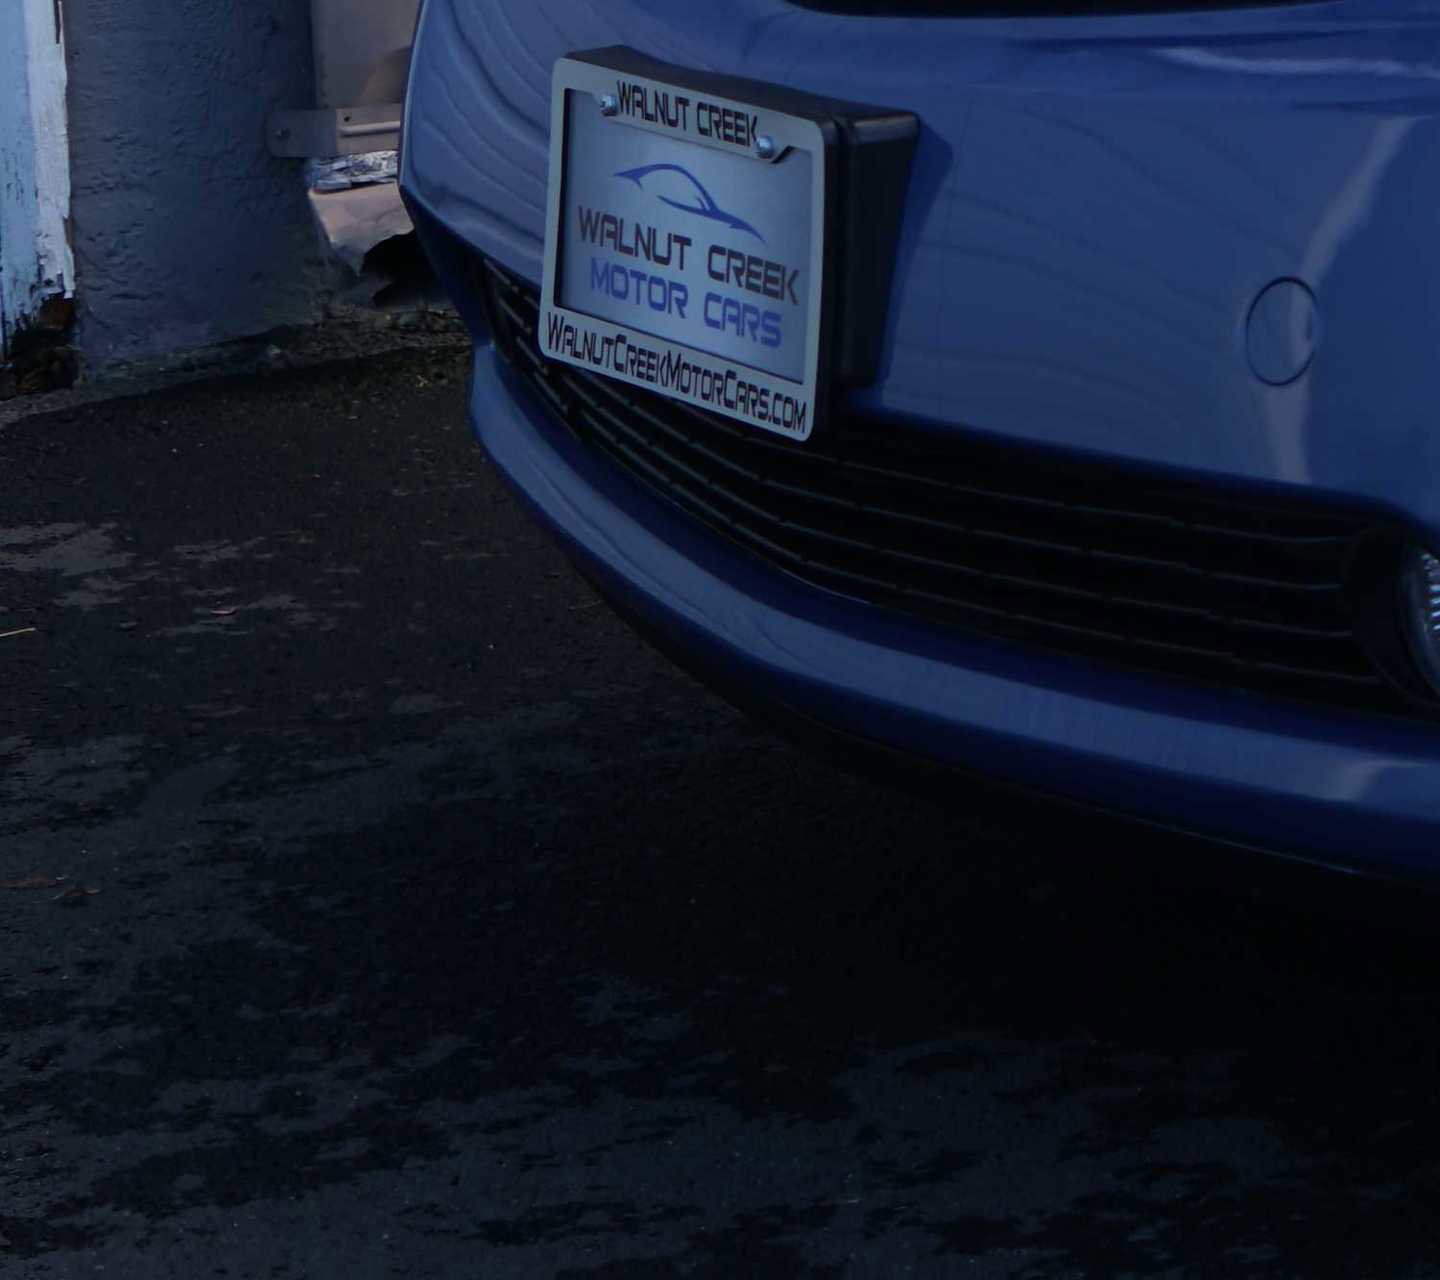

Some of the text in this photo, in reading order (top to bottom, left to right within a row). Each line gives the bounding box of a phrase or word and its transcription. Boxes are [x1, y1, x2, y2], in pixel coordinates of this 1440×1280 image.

[616, 80, 759, 146] WALNUT CREEK
[578, 205, 801, 306] WALNUT CREEK
[590, 257, 784, 349] MOTOR CARS
